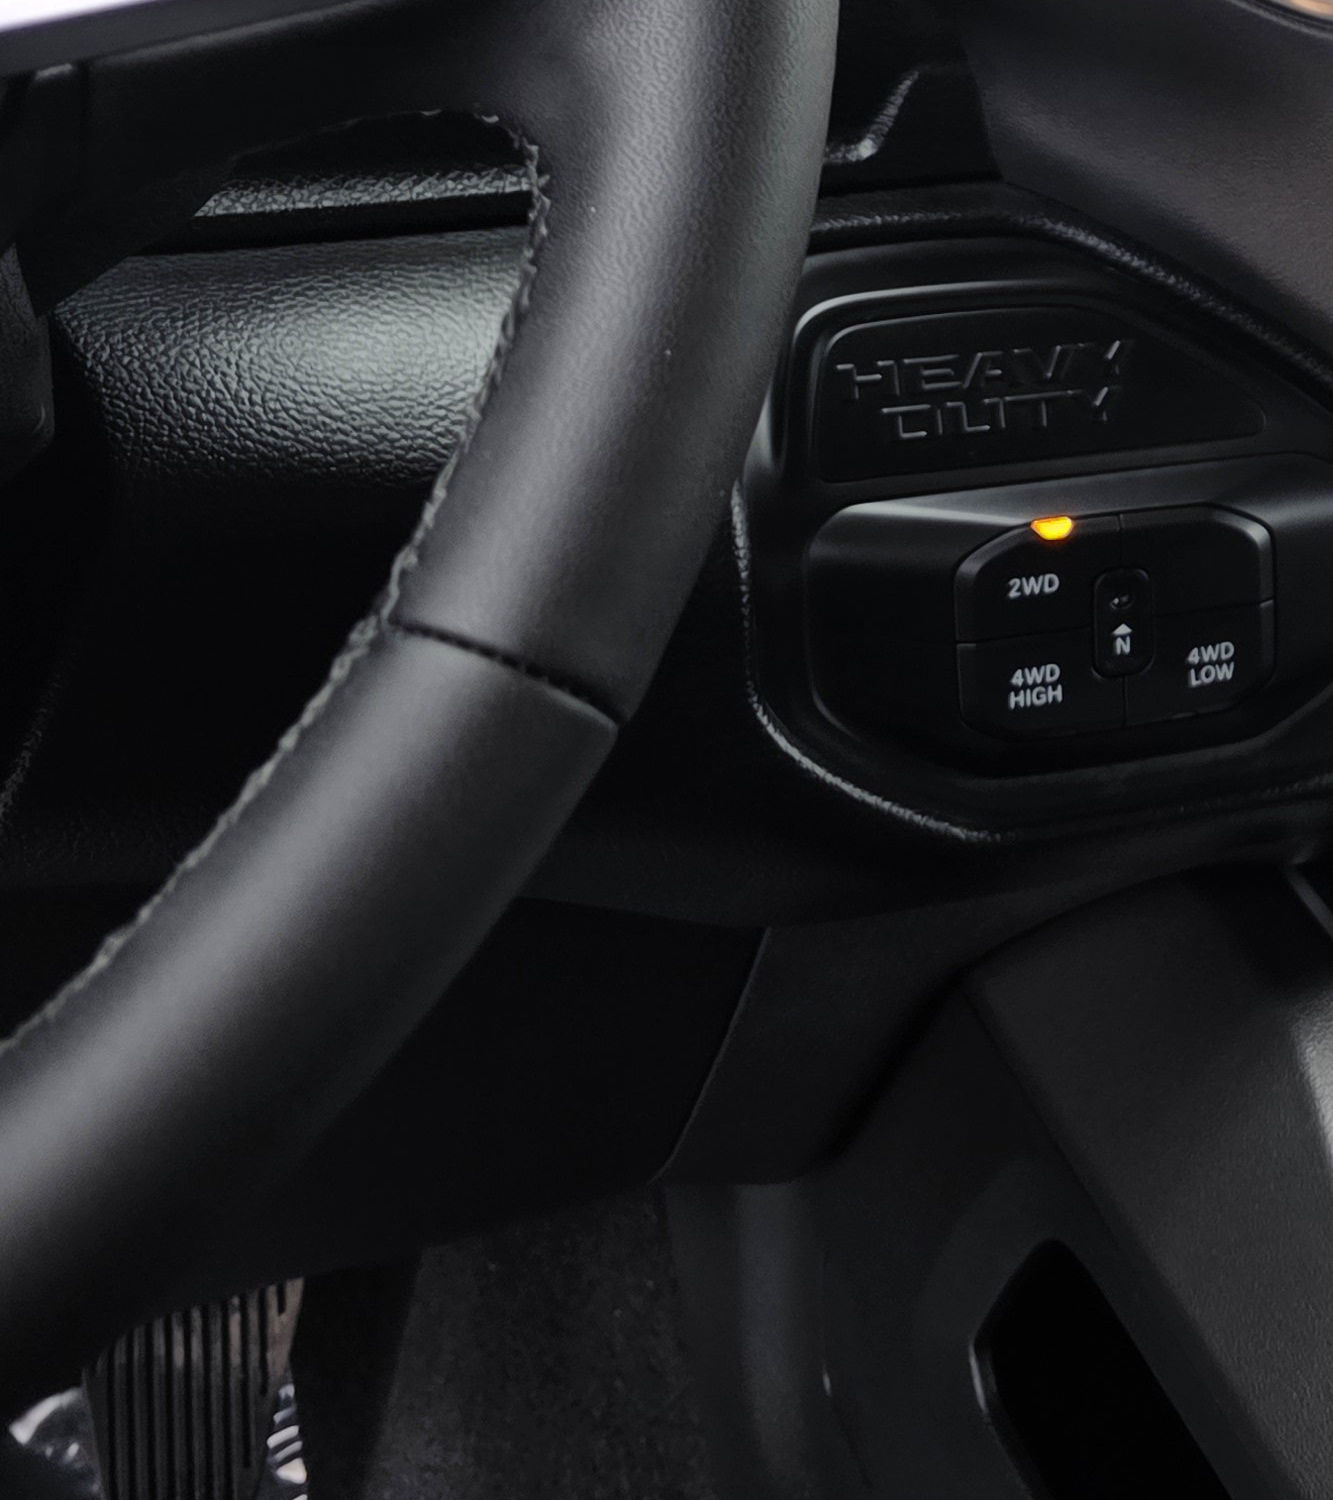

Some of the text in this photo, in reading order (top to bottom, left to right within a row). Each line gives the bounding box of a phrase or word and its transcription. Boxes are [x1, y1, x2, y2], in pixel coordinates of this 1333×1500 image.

[834, 338, 1134, 402] HEAVY
[880, 384, 1124, 440] DUTY
[1006, 572, 1060, 600] 2WD
[1115, 636, 1131, 656] N
[1186, 640, 1236, 666] 4WD
[1010, 663, 1061, 688] 4WD
[1188, 661, 1236, 689] LOW
[1008, 684, 1063, 710] HIGH
